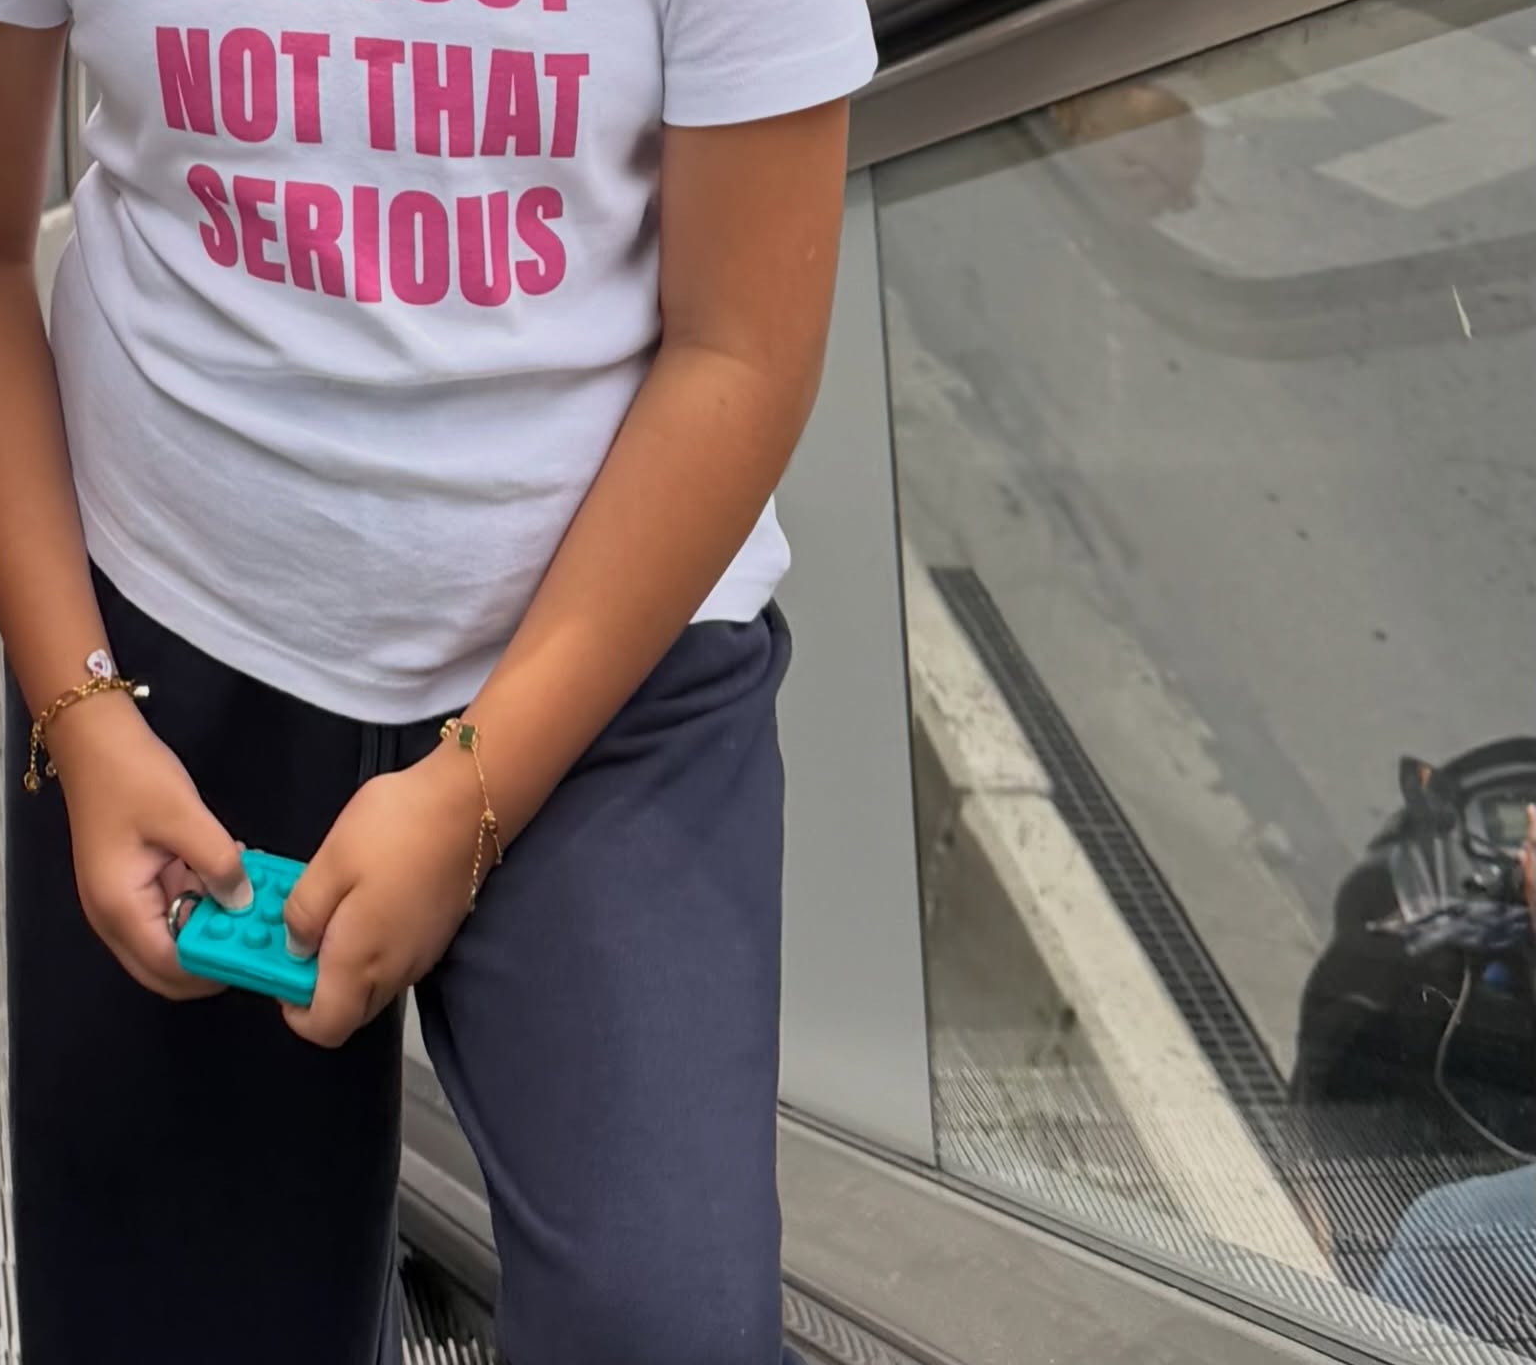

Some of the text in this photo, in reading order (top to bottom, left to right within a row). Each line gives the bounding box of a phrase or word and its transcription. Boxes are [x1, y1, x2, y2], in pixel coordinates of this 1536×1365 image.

[156, 27, 590, 158] NOT THAT
[186, 163, 566, 307] SERIOUS
